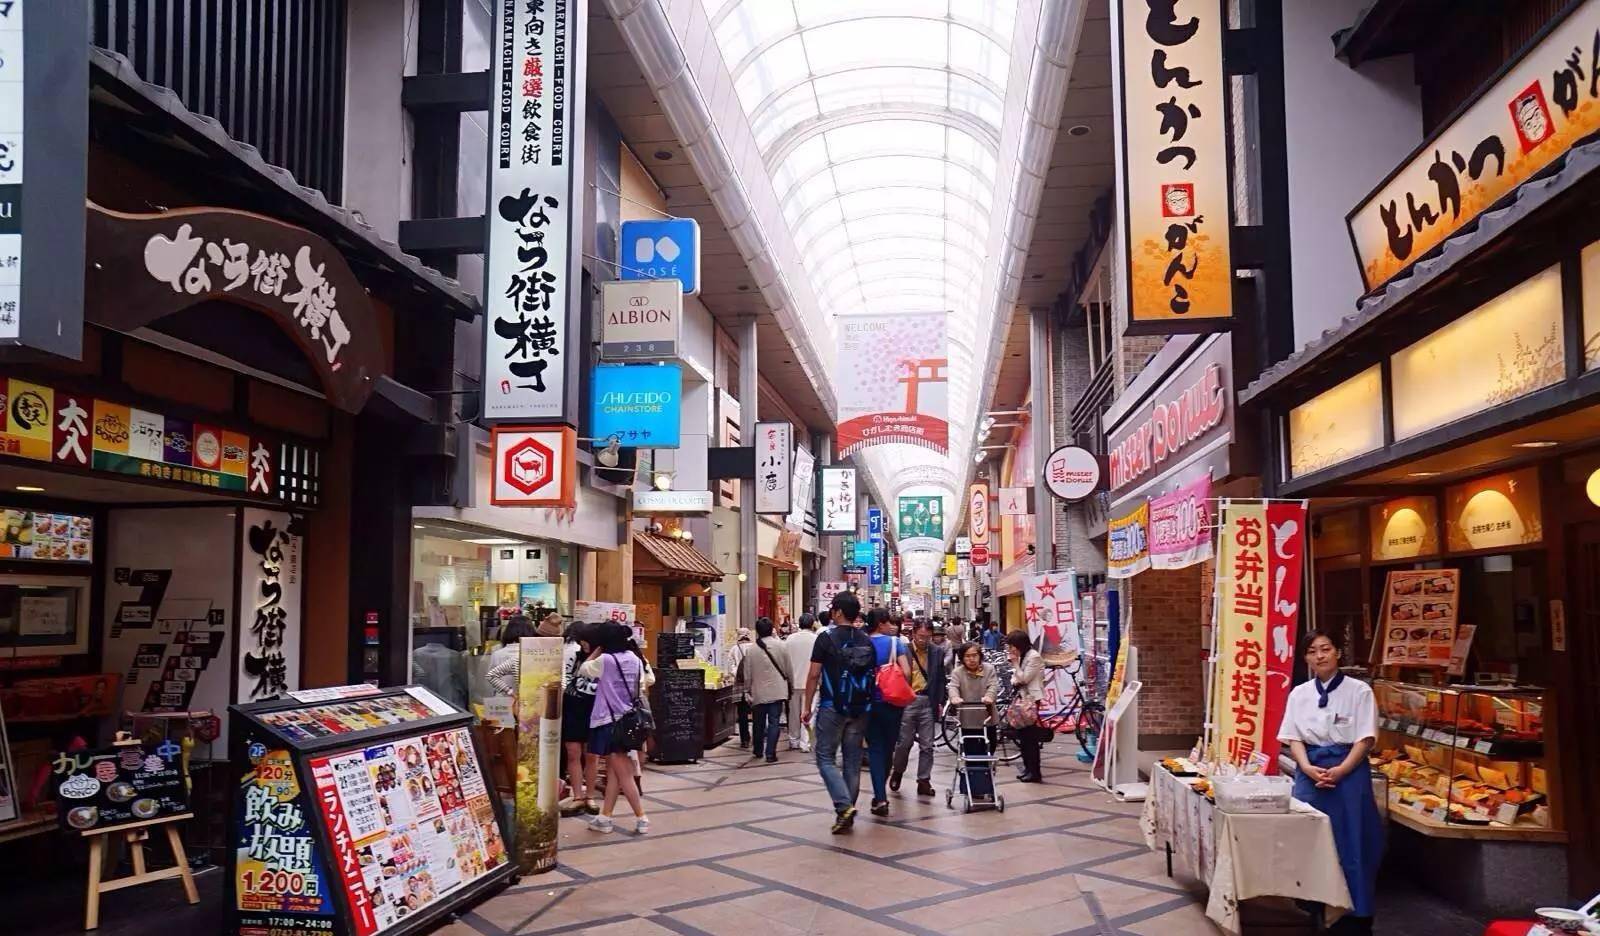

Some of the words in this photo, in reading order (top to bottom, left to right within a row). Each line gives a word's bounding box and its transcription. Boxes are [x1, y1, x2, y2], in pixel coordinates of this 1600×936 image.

[520, 0, 545, 166] 東向き厳選飲食街
[1146, 0, 1203, 171] とんかつ
[501, 122, 511, 164] COURT
[552, 119, 562, 160] COURT
[1379, 135, 1505, 261] とんかつ
[144, 223, 351, 363] なら街横丁
[494, 187, 560, 393] なら街横丁
[1163, 215, 1204, 314] がんこ
[608, 309, 671, 325] ALBION
[57, 398, 89, 465] 大入
[595, 392, 672, 404] SHISEIDO
[603, 405, 664, 414] CHAINSTORE
[244, 785, 304, 828] 飲み
[323, 791, 371, 928] ランチメニュー
